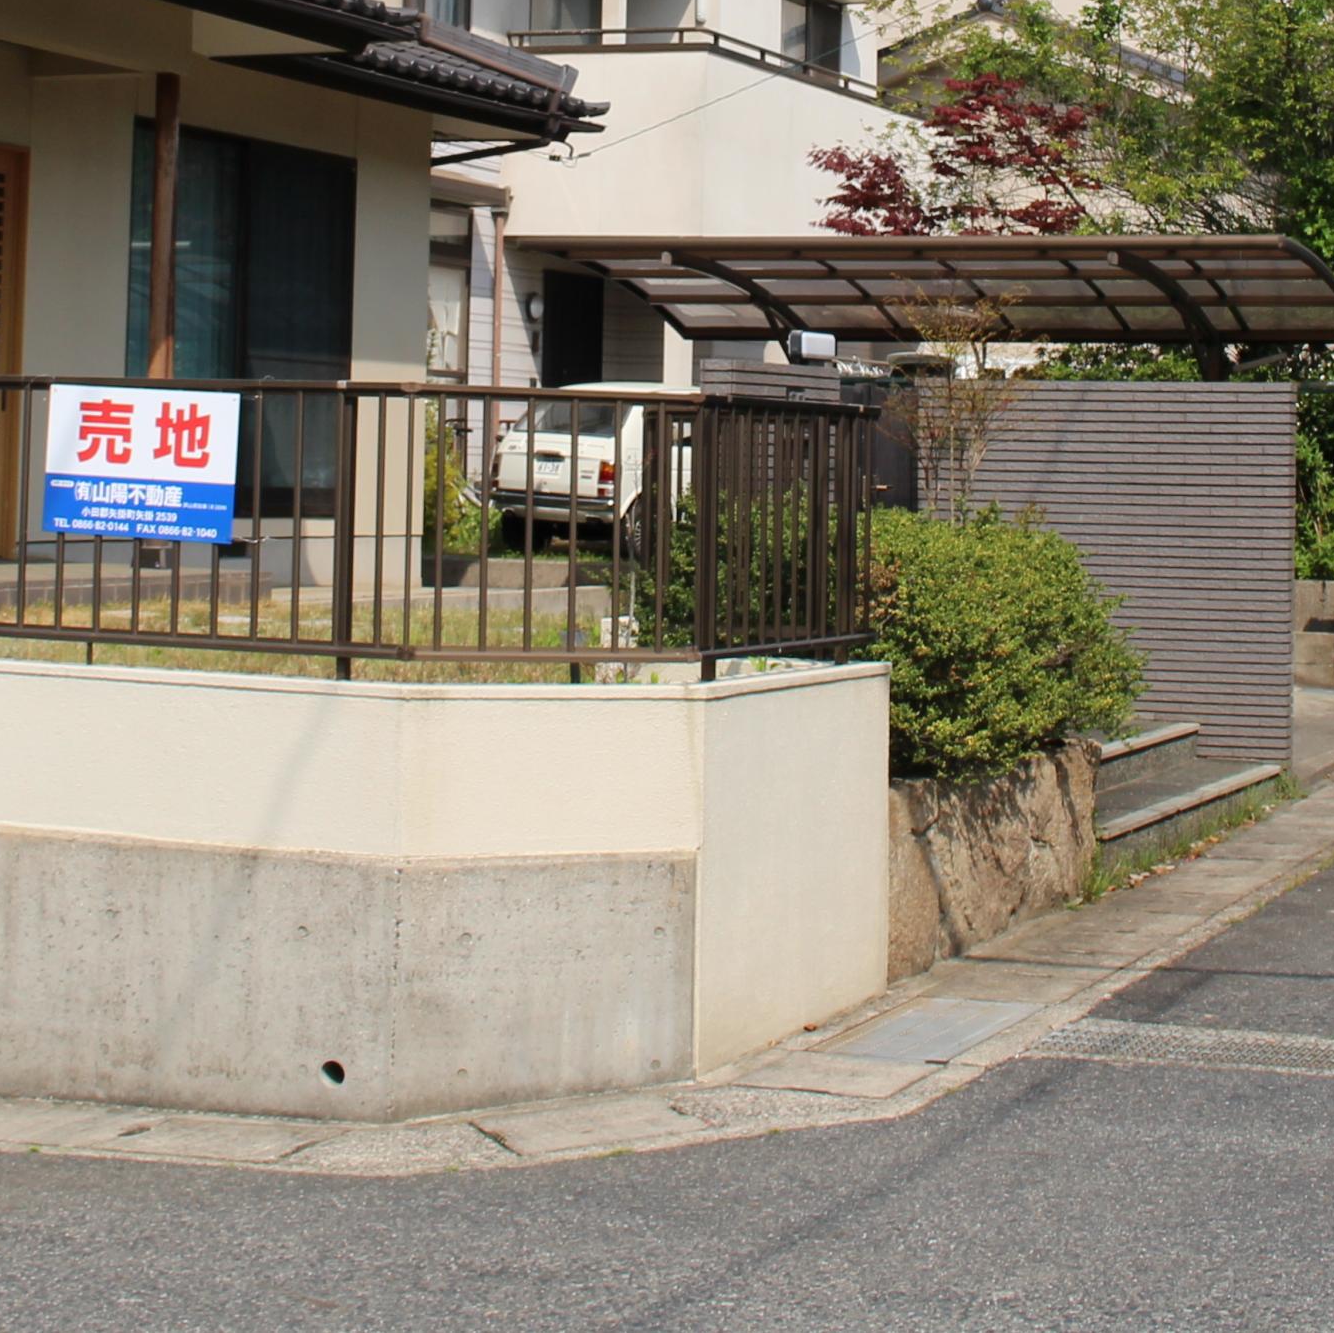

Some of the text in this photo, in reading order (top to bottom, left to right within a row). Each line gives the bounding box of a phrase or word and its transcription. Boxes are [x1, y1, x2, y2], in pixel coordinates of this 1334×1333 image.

[77, 399, 211, 468] 売地
[53, 517, 70, 528] TEL
[136, 523, 156, 535] FAX
[155, 512, 178, 523] 2539
